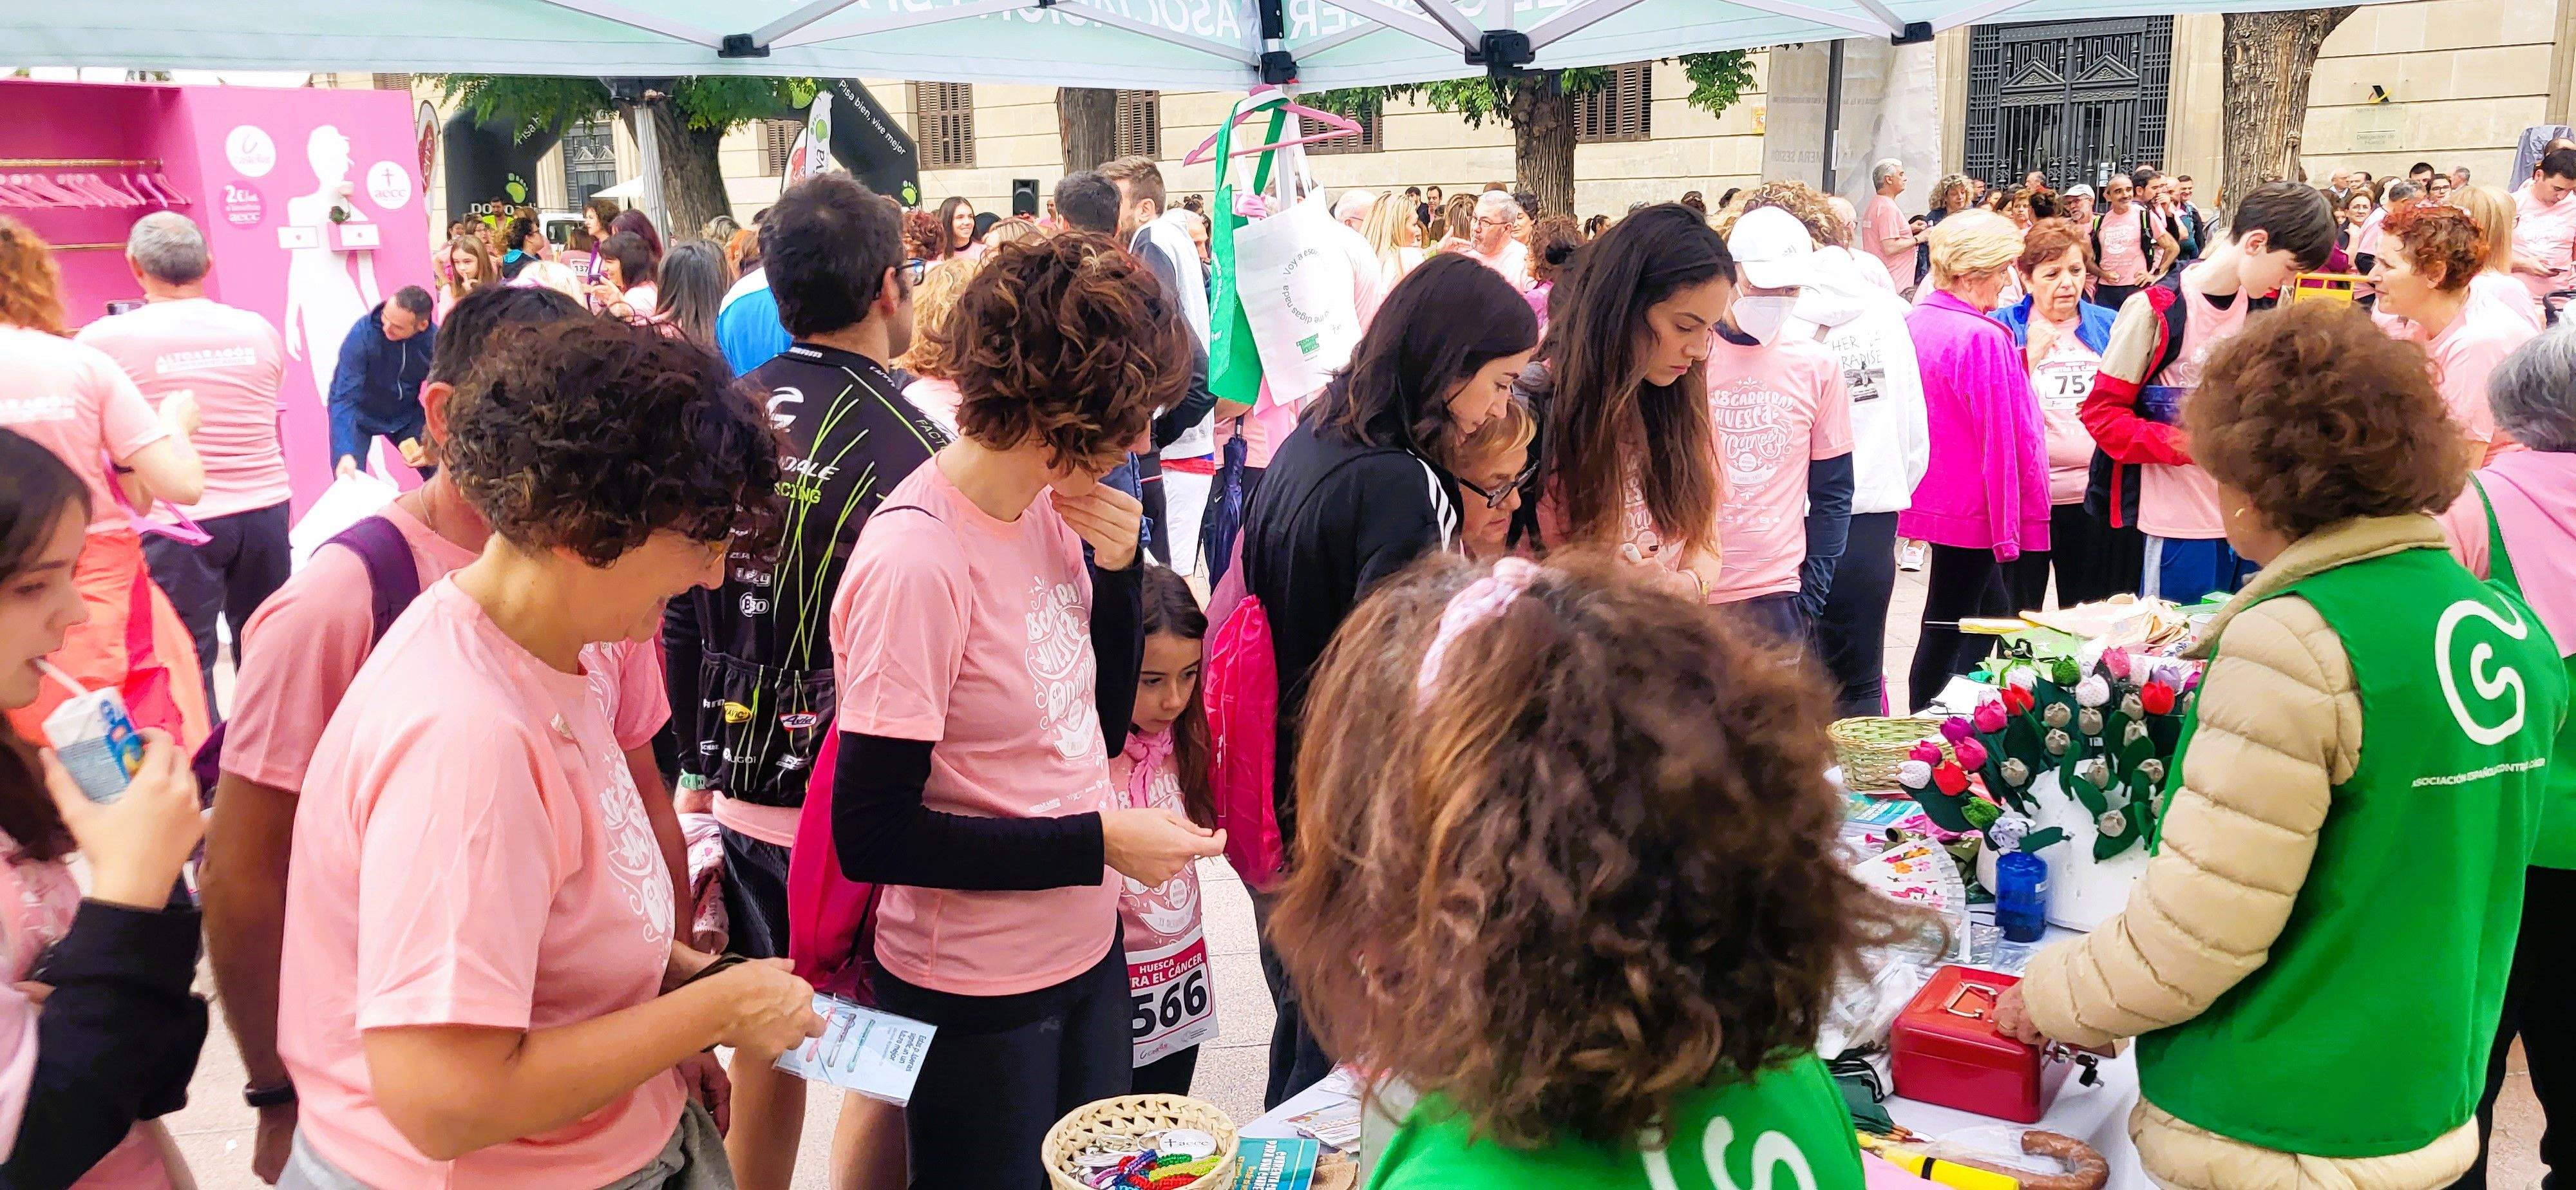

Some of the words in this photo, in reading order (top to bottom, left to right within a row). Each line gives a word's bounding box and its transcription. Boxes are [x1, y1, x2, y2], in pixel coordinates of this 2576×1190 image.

[838, 80, 855, 102] Pisa
[854, 97, 871, 121] bien,
[872, 118, 886, 135] vive
[886, 133, 907, 156] mejor
[374, 189, 406, 198] aecc
[1283, 260, 1298, 277] Voy
[1282, 285, 1293, 308] nada
[1292, 307, 1312, 325] digas
[1139, 958, 1175, 974] HUESCA
[1152, 972, 1166, 984] EL
[1168, 952, 1203, 979] CÁNCER
[1132, 969, 1208, 1039] 566
